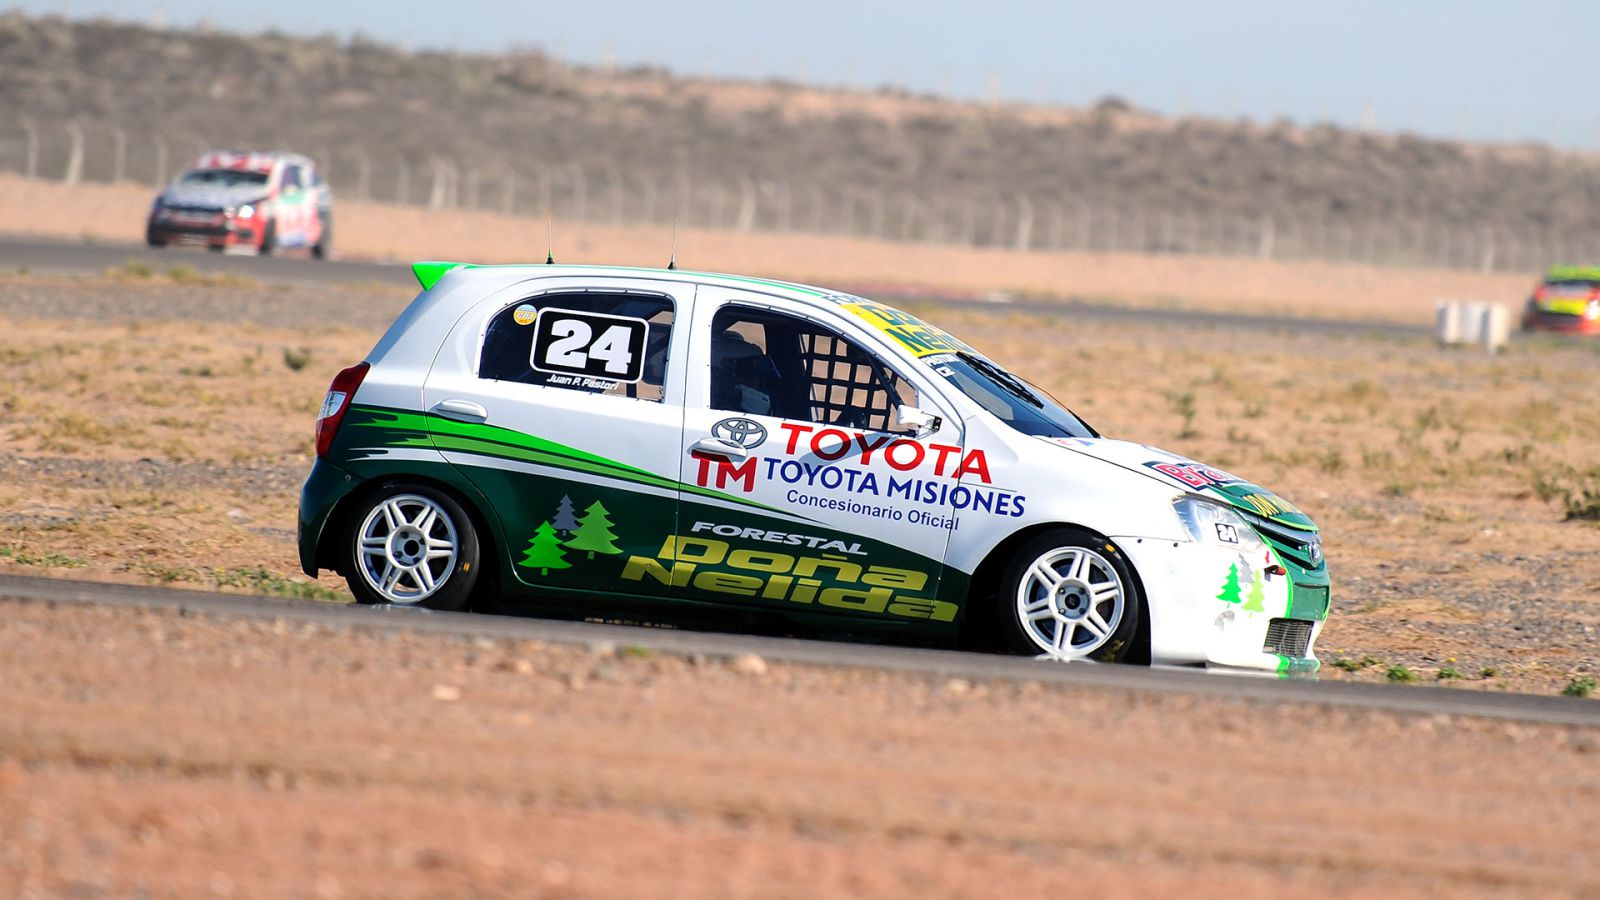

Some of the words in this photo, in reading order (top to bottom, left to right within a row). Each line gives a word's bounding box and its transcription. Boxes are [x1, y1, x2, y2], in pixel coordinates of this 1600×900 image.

[545, 319, 632, 375] 24
[546, 374, 573, 385] Juan
[572, 376, 581, 386] P.
[581, 378, 620, 391] Pastori
[691, 449, 758, 492] TM
[780, 423, 992, 484] TOYOTA
[764, 457, 879, 495] TOYOTA
[887, 475, 1026, 518] MISIONES
[786, 489, 902, 521] Concesionario
[908, 508, 960, 531] Oficial
[657, 534, 929, 591] Doña
[691, 521, 868, 556] FORESTAL
[620, 555, 960, 623] Nelida
